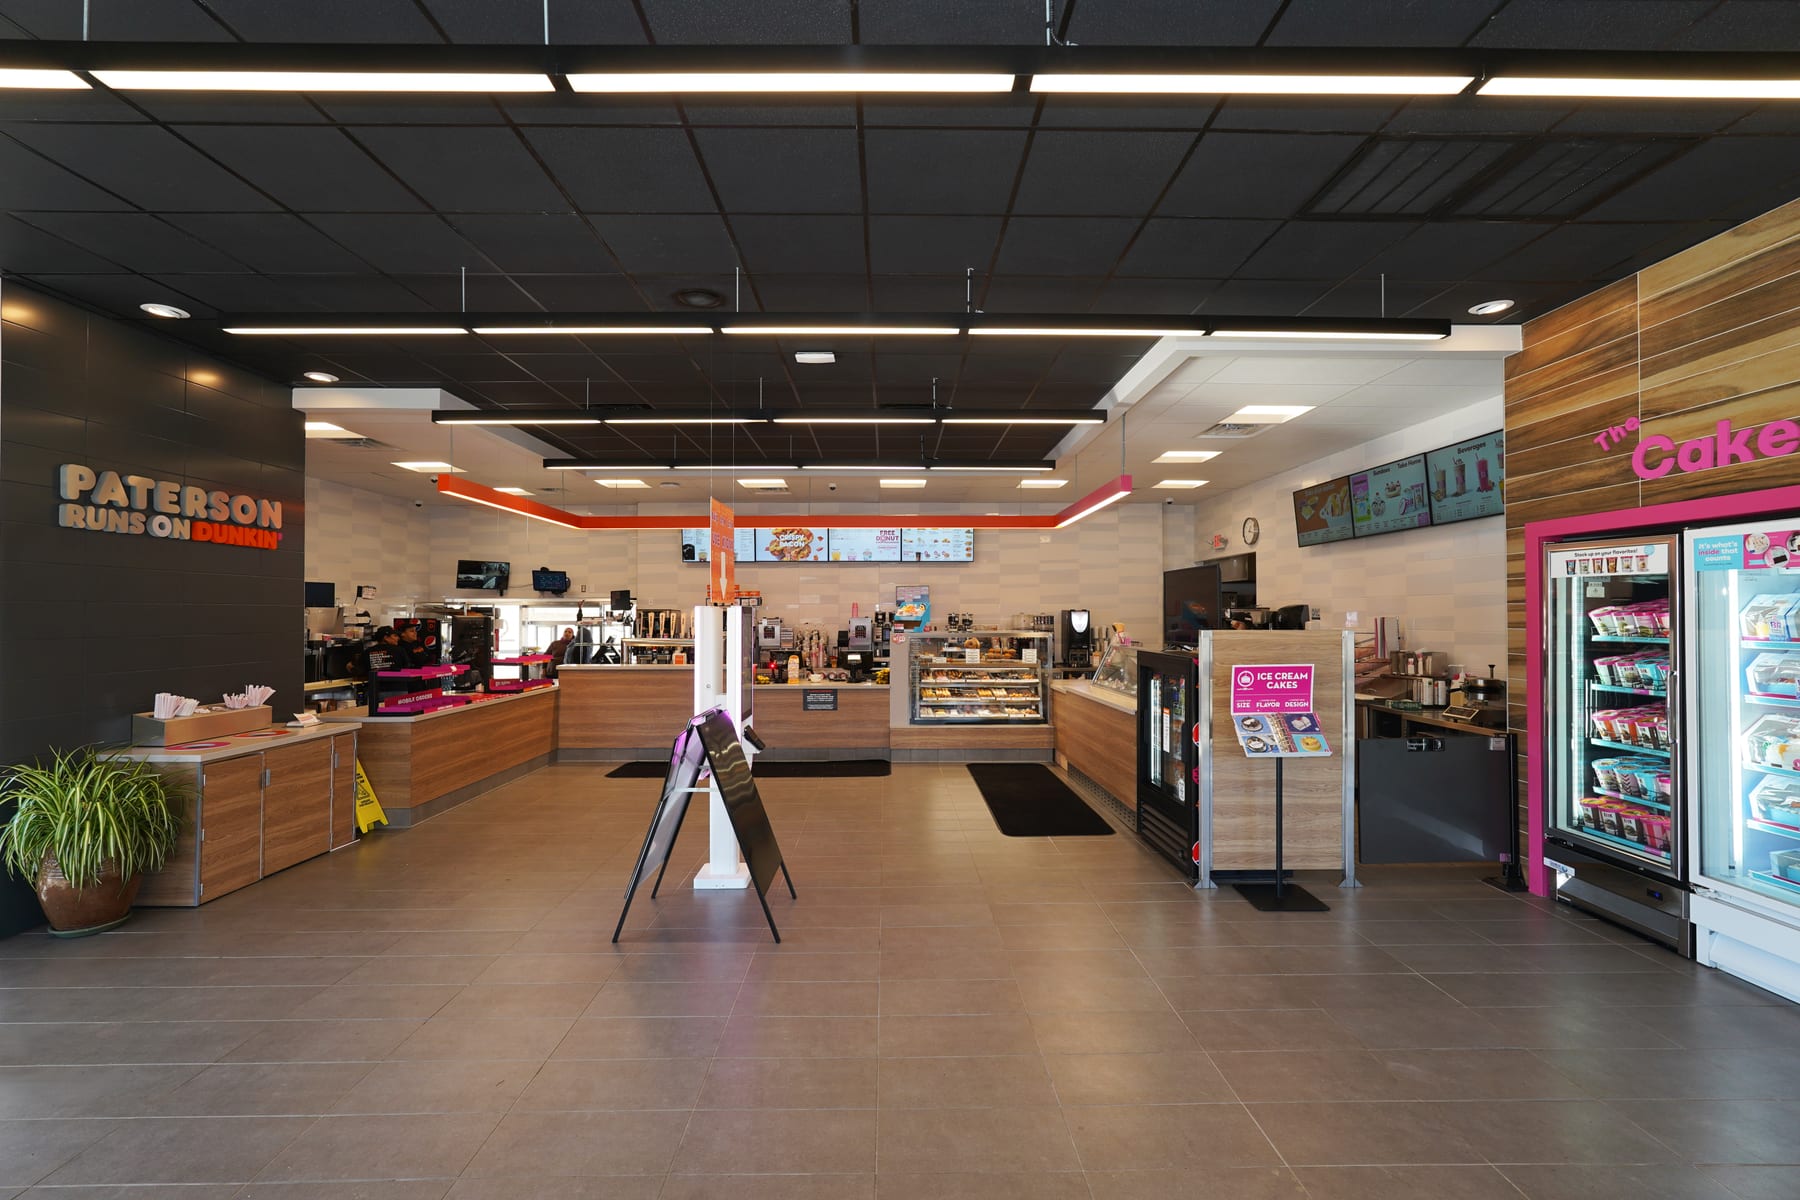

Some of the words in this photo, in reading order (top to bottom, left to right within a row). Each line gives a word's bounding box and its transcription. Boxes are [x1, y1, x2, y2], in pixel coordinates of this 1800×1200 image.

[1457, 442, 1486, 454] Beverages
[1593, 416, 1640, 452] The
[1631, 418, 1800, 480] Cake
[59, 463, 282, 529] PATERSON
[59, 503, 146, 535] RUNS
[147, 514, 190, 540] ON
[191, 521, 282, 549] DUNKIN'
[1257, 672, 1273, 680] ICE
[1274, 672, 1308, 680] CREAM
[1266, 681, 1298, 689] CAKES
